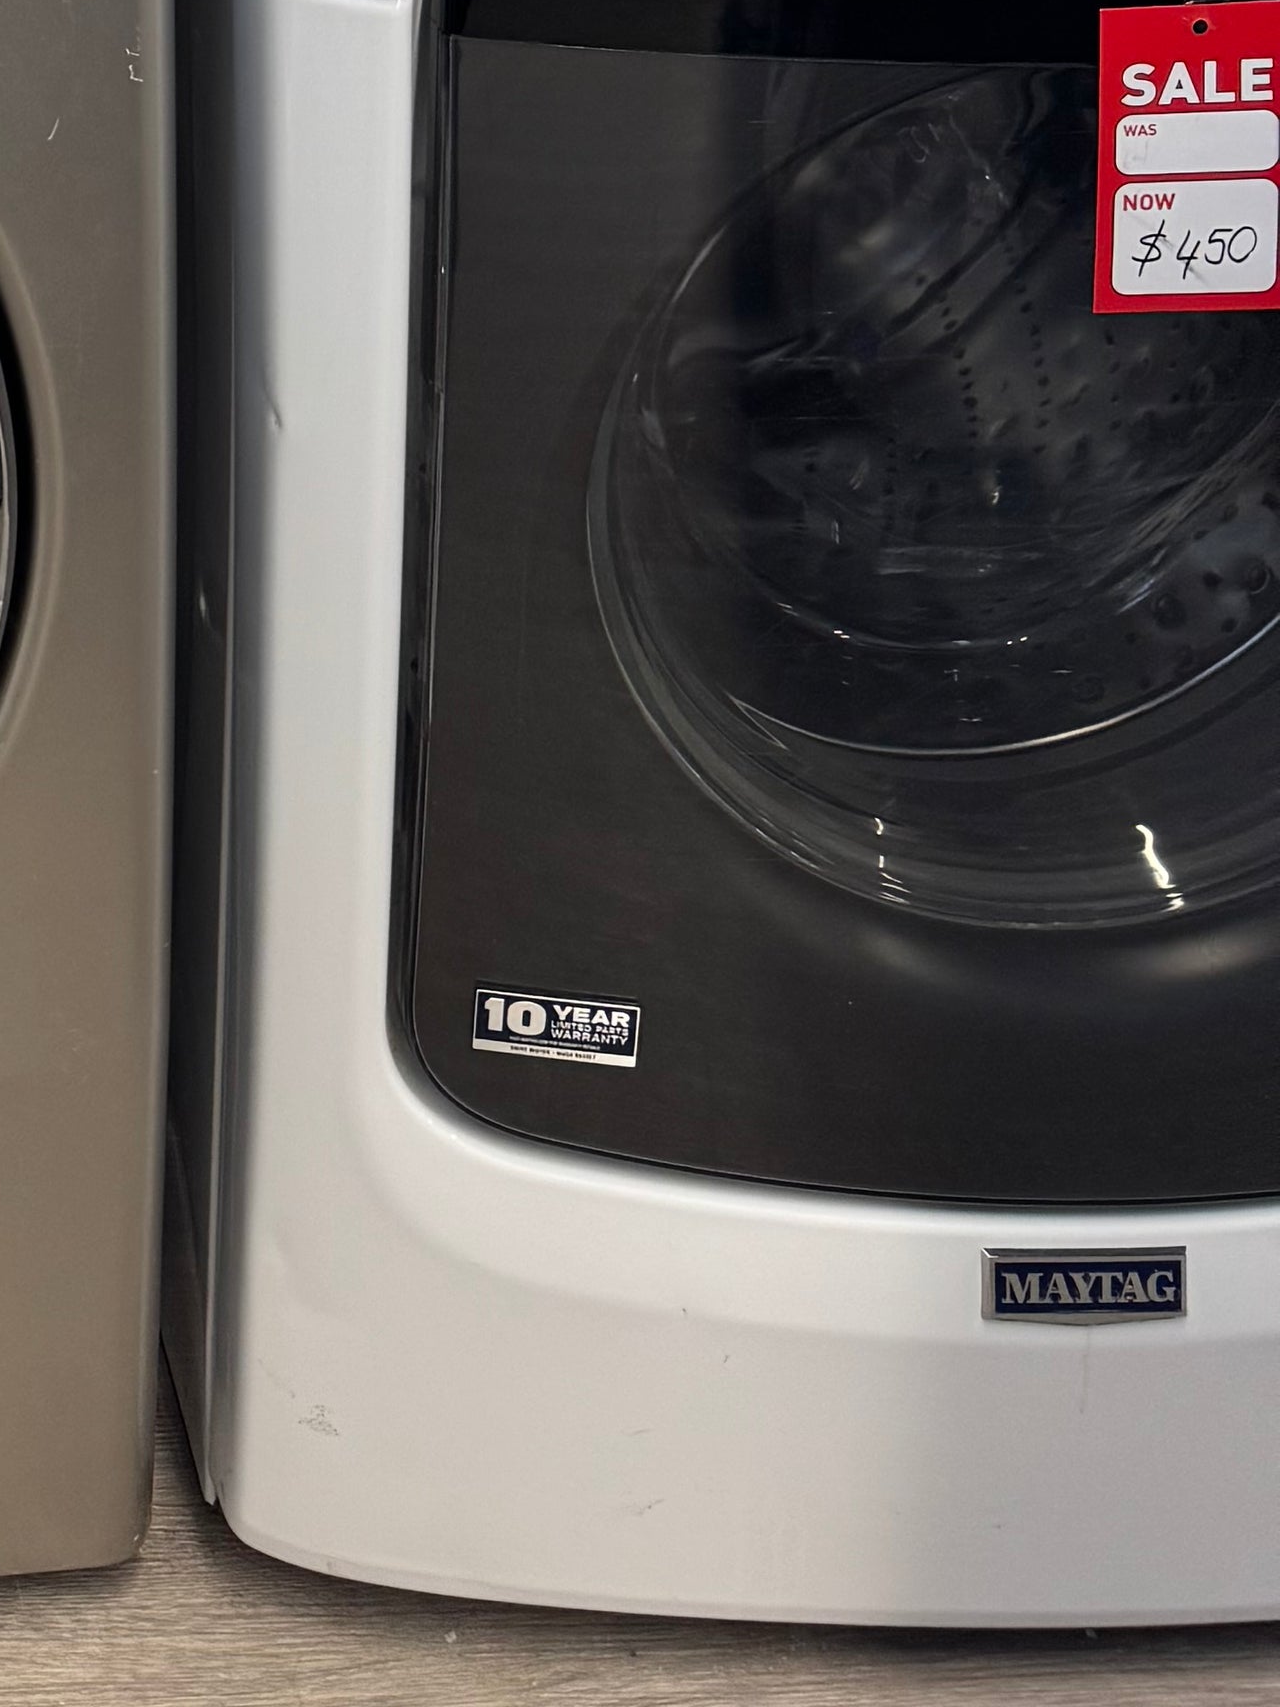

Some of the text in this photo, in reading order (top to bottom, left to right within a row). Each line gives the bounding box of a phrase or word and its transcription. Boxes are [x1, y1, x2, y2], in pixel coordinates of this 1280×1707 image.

[1121, 58, 1274, 106] SALE
[1124, 124, 1157, 137] WAS
[1123, 194, 1175, 211] NOW
[1132, 219, 1257, 279] $450
[484, 997, 630, 1035] 10 YEAR
[551, 1030, 628, 1045] WARRANTY
[1001, 1270, 1176, 1304] MAYTAG
